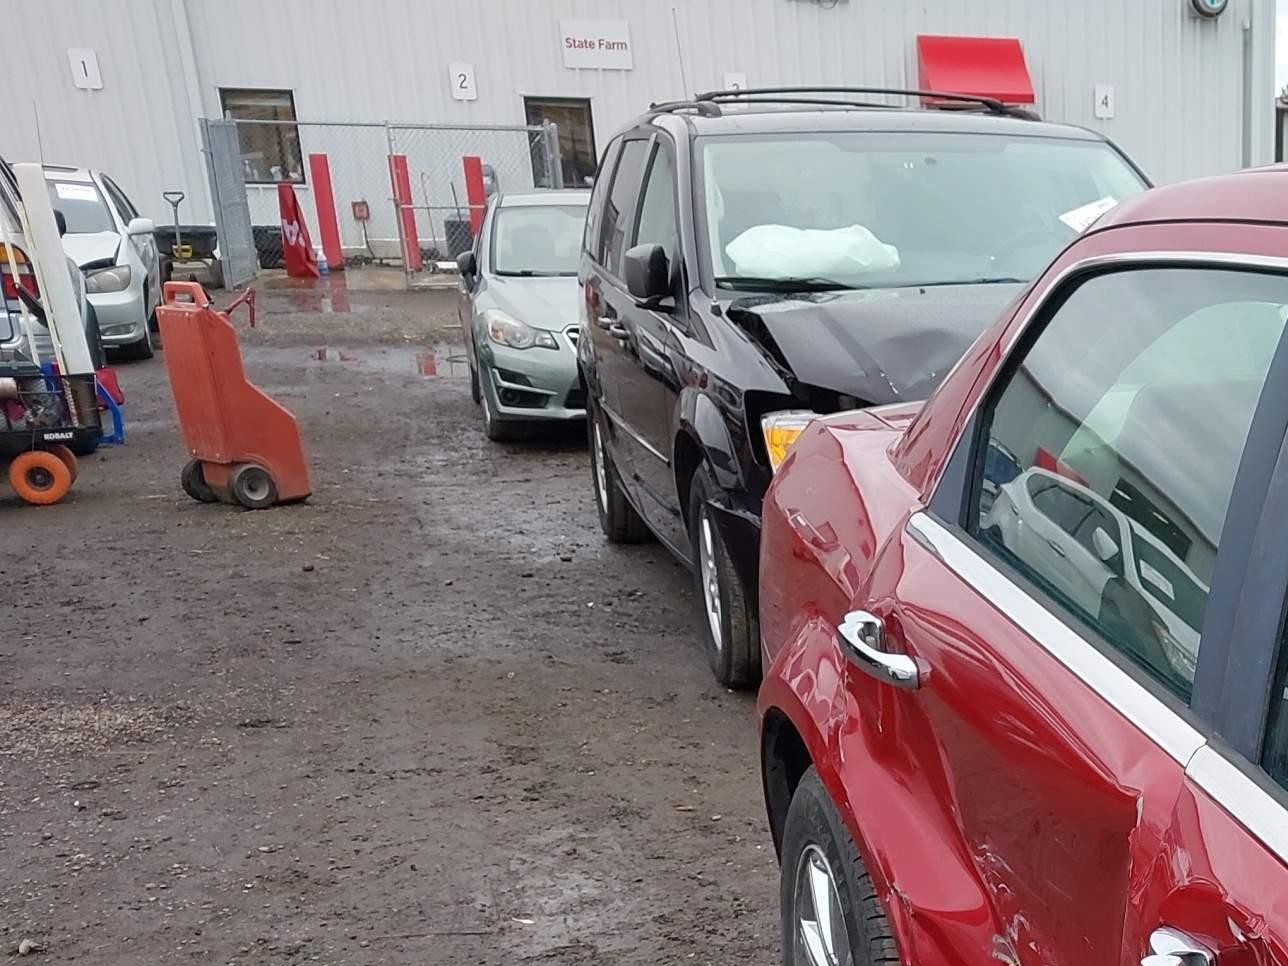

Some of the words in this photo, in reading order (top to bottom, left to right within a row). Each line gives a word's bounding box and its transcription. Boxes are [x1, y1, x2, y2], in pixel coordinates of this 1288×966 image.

[565, 37, 595, 49] State
[598, 38, 628, 50] Farm
[81, 60, 88, 77] 1
[457, 73, 468, 89] 2
[1101, 94, 1109, 109] 4
[43, 432, 74, 440] KOBALT
